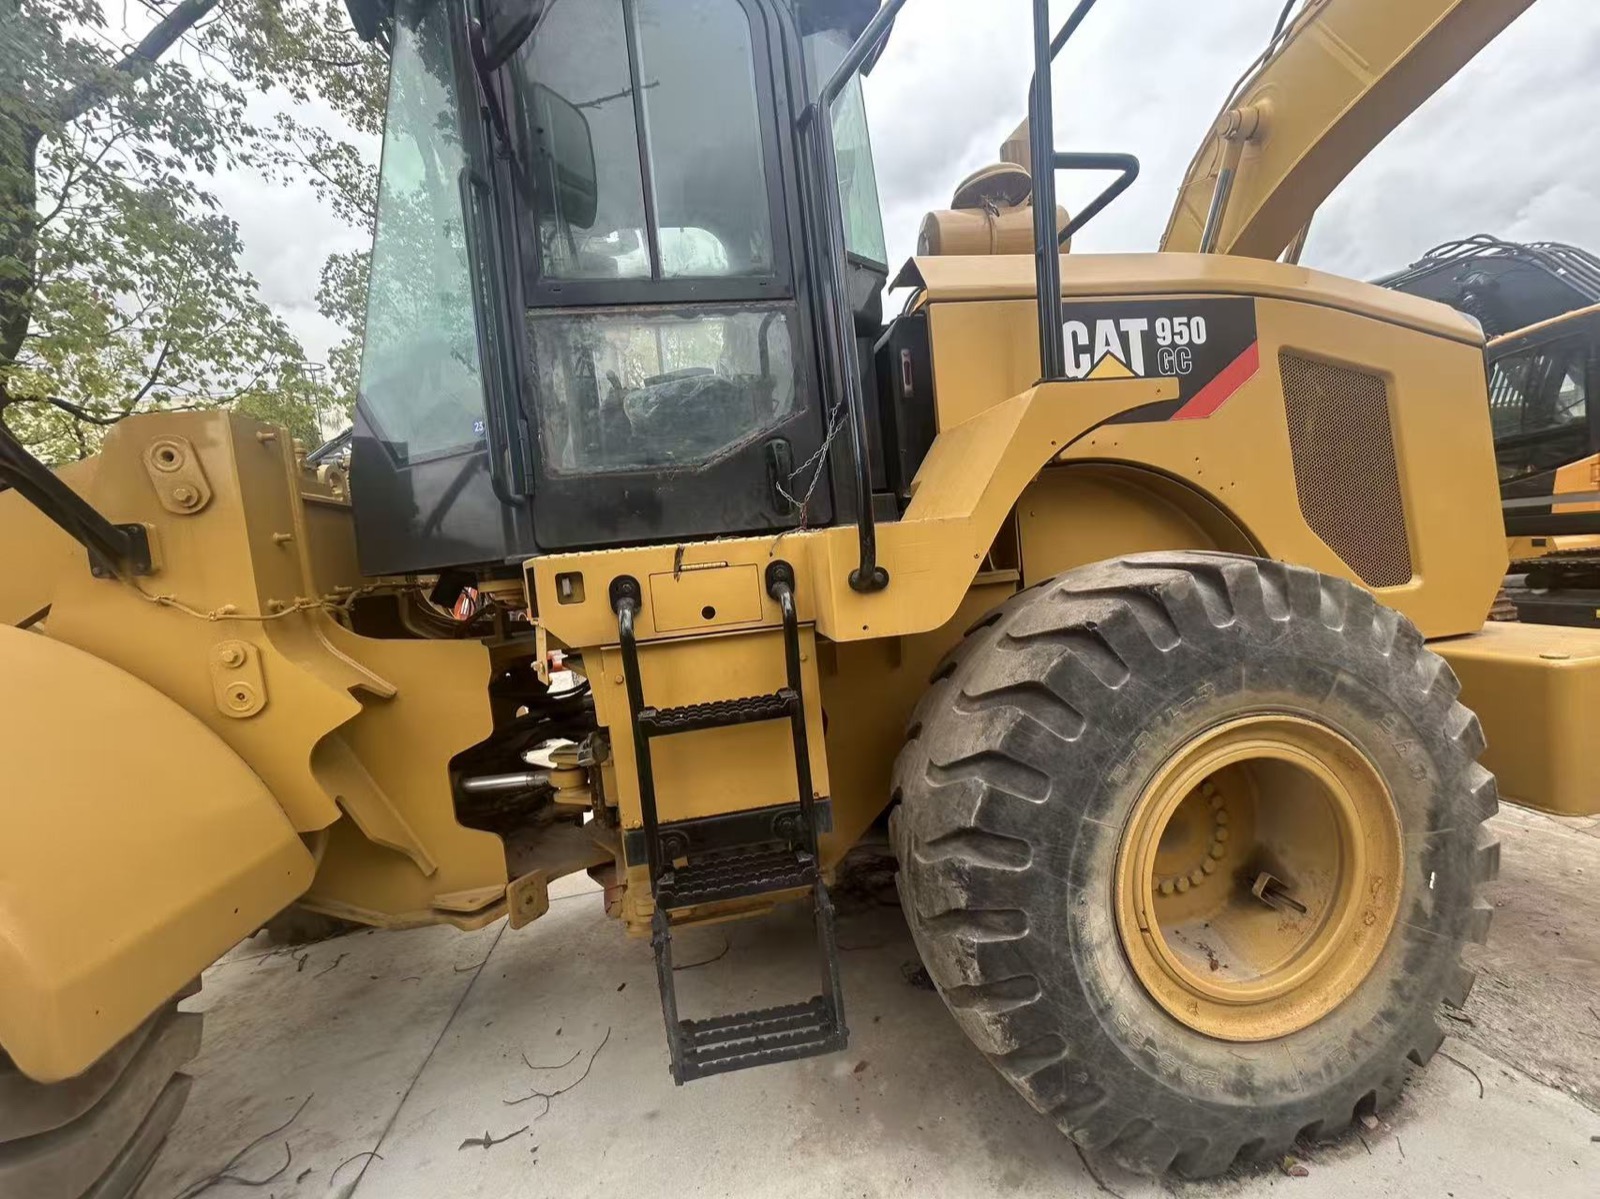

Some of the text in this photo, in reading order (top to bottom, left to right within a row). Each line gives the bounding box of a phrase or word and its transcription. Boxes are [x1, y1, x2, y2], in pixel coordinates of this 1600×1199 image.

[1155, 316, 1207, 346] 950
[1062, 318, 1148, 379] CAT
[1157, 347, 1192, 375] GC
